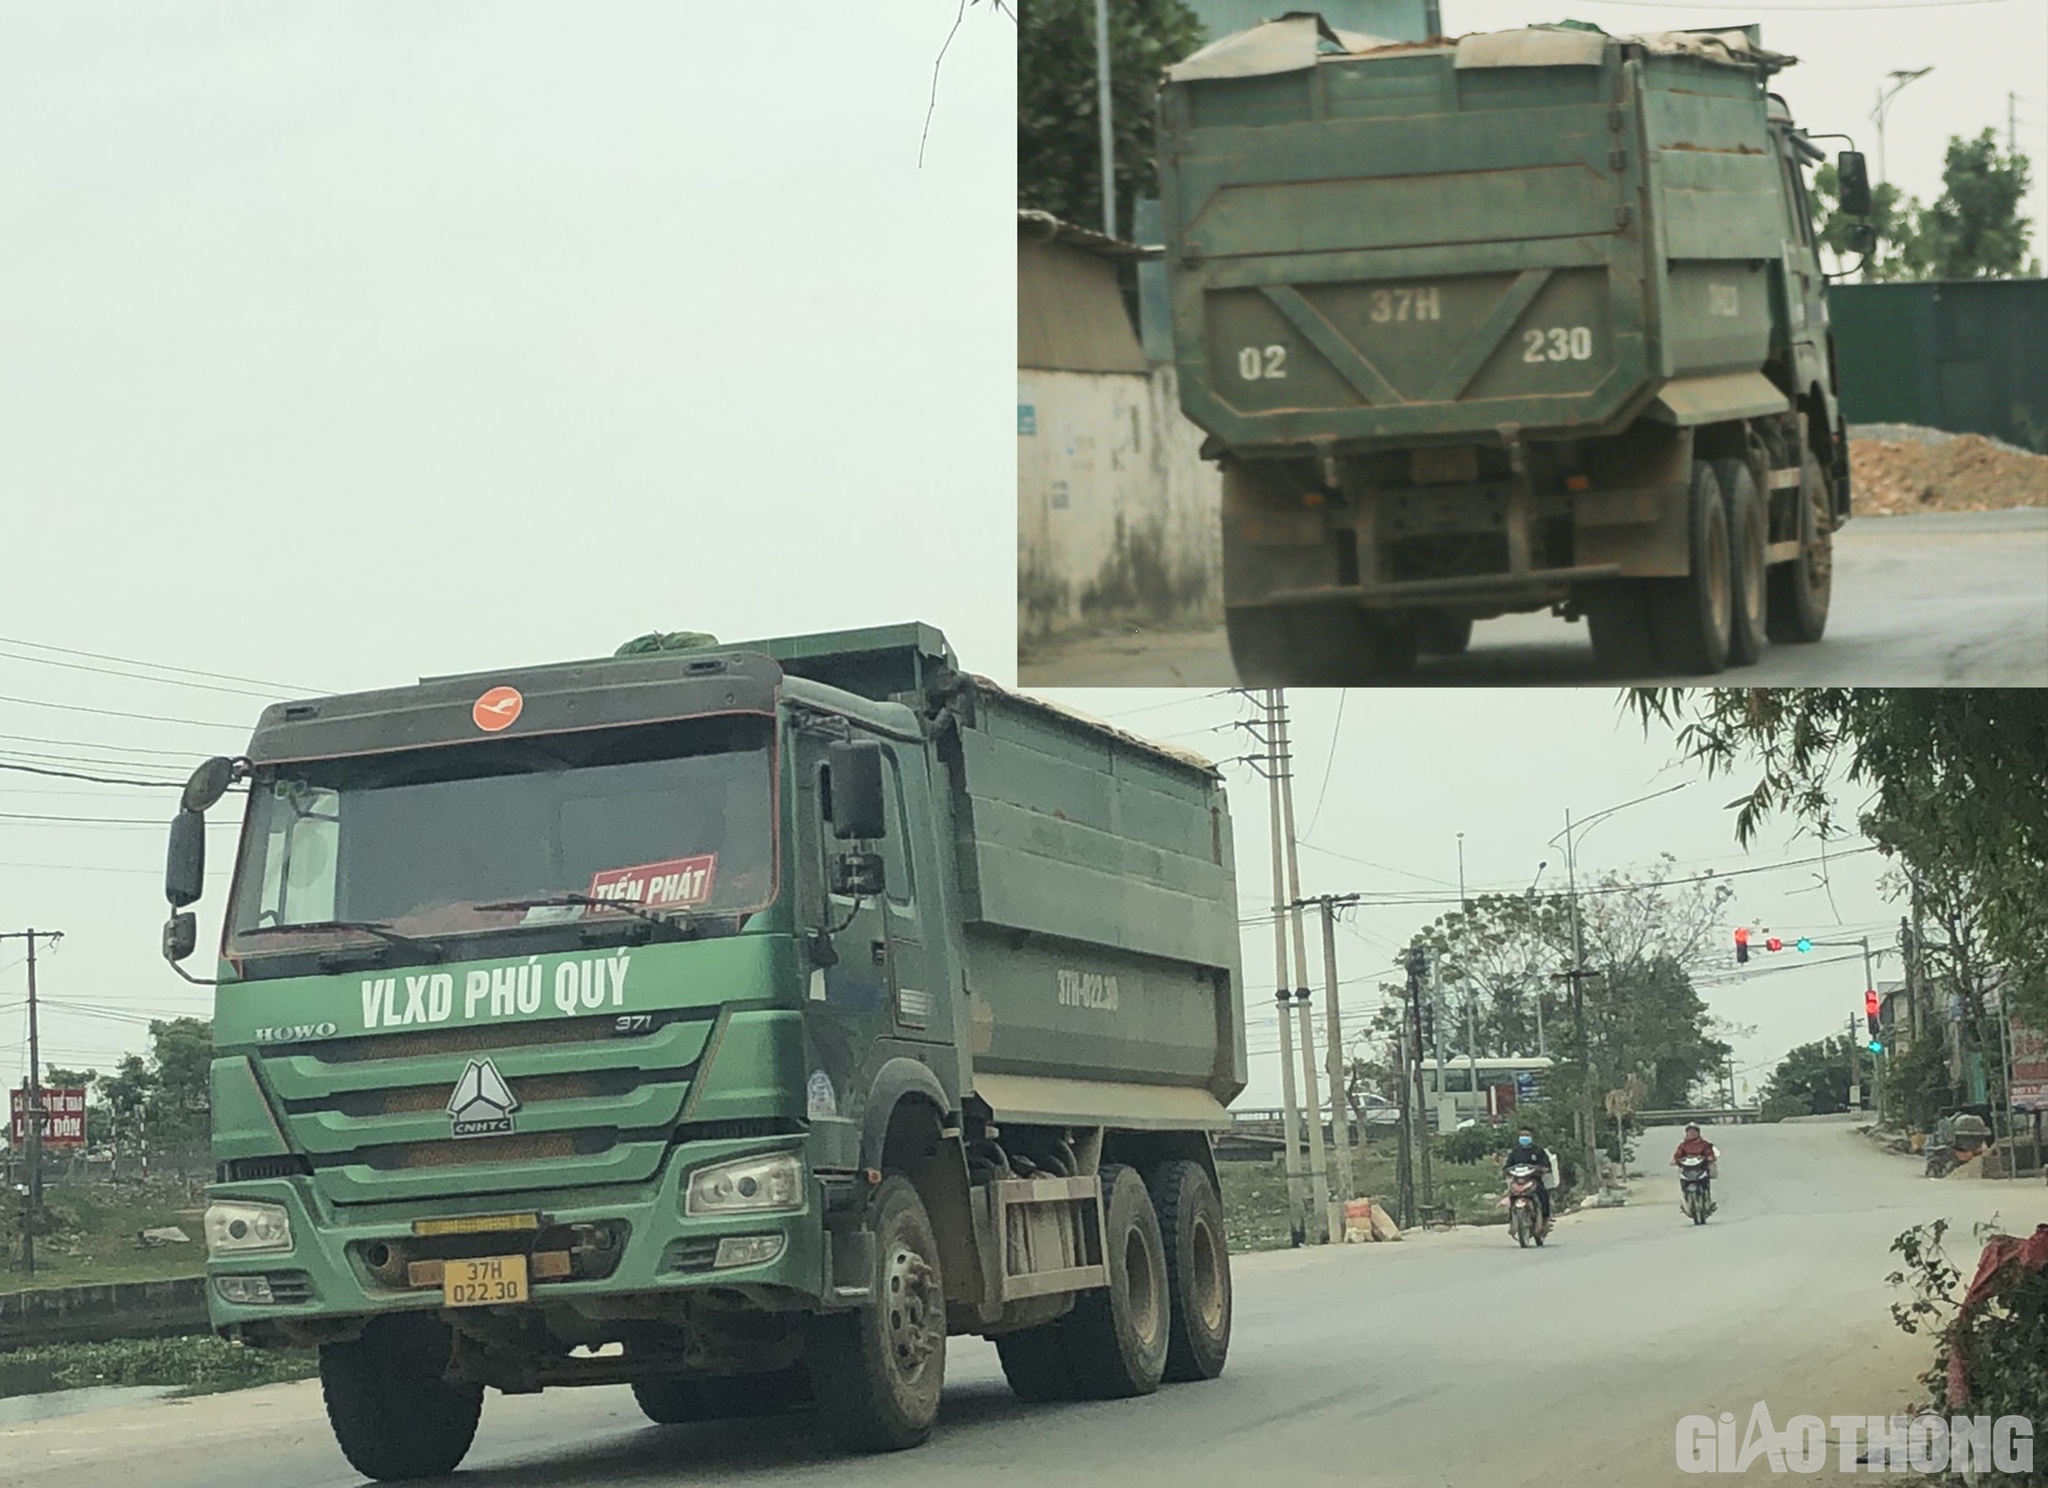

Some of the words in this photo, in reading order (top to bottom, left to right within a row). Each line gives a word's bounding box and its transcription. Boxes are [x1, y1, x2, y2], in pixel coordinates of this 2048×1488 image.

[1369, 287, 1440, 323] 37H
[1238, 345, 1287, 381] 02
[1522, 326, 1593, 363] 230
[595, 872, 645, 911] TIẾN
[646, 866, 706, 904] PHÁT
[362, 973, 453, 1028] VLXD
[465, 956, 542, 1018] PHÚ
[555, 946, 631, 1016] QUÝ
[255, 1022, 337, 1041] HOWO
[615, 1014, 652, 1030] 371
[455, 1121, 508, 1133] CNHTC
[467, 1261, 502, 1280] 37H
[453, 1281, 518, 1303] 022.30
